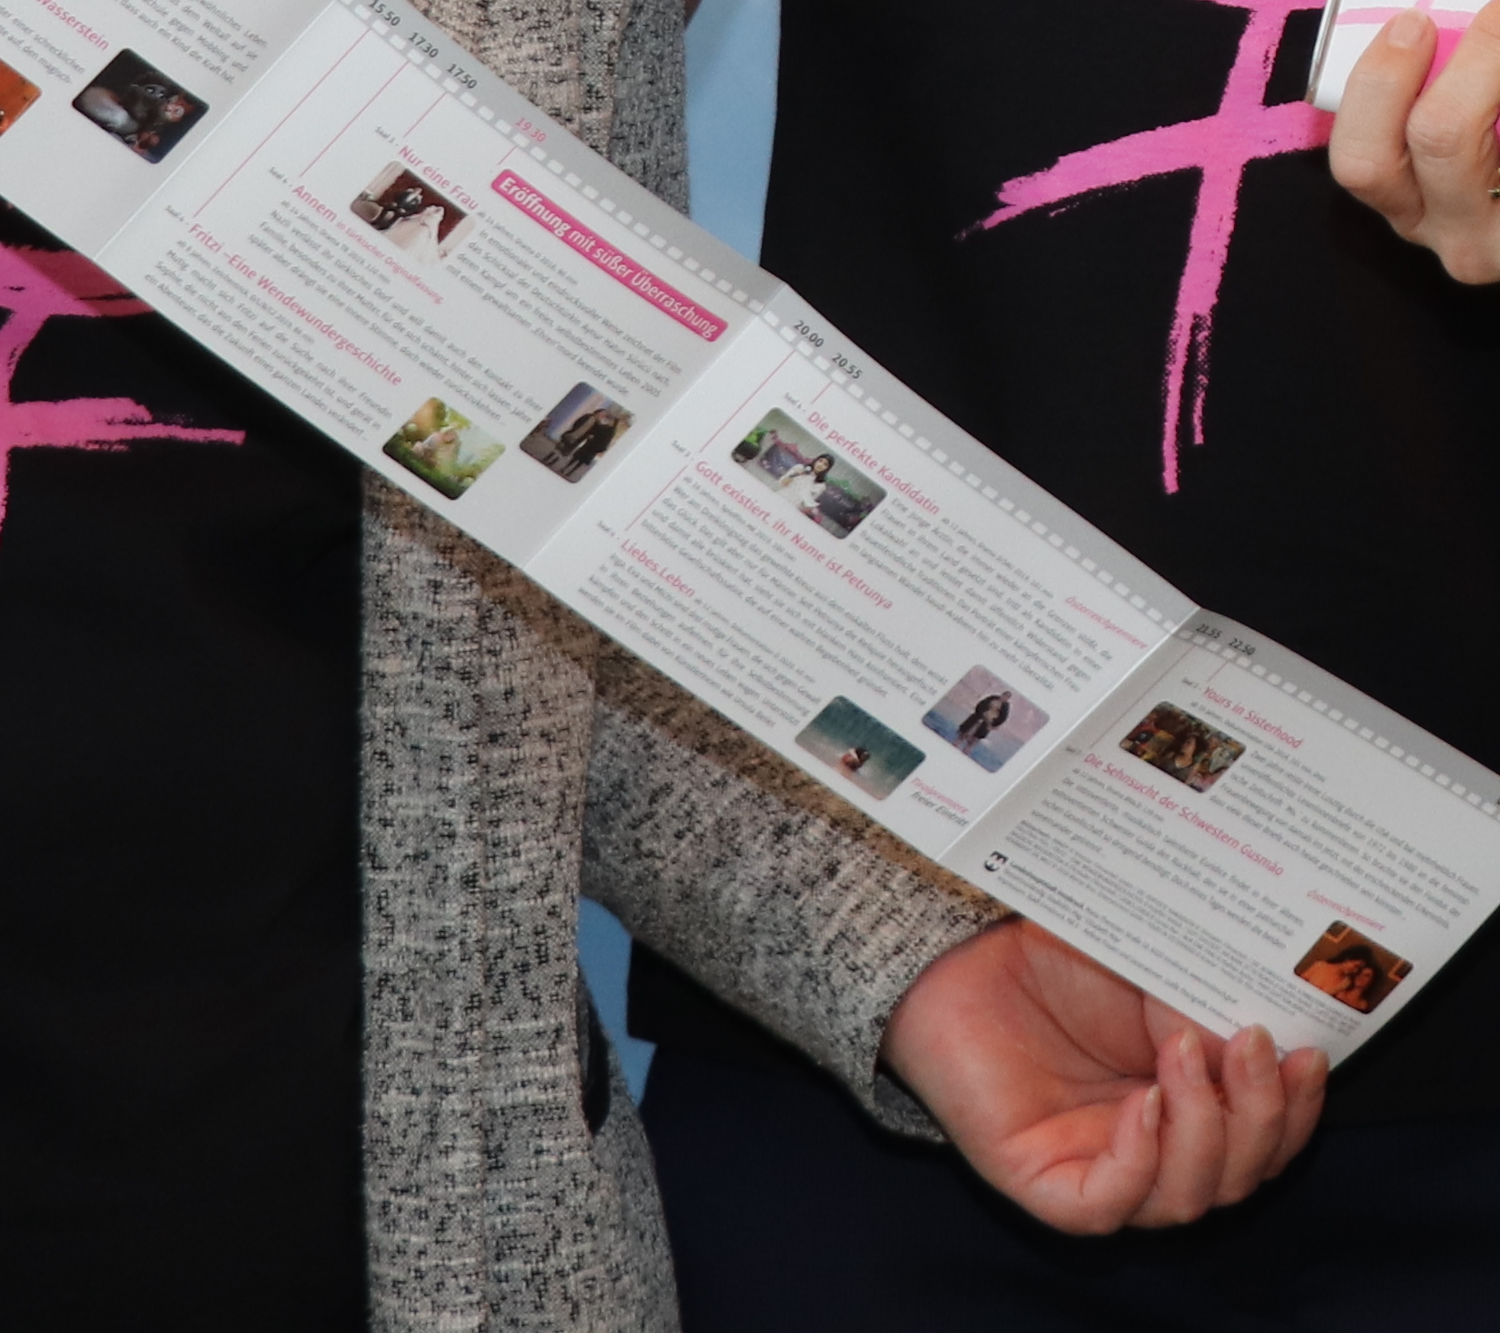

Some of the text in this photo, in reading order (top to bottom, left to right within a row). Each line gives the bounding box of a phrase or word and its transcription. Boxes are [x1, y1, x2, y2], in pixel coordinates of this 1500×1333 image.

[408, 32, 438, 58] 17.30
[447, 63, 477, 89] 17.50
[292, 182, 339, 221] Annem
[398, 145, 478, 210] Nur eine Frau
[496, 173, 721, 341] Eröffnung mit süßer Überraschung
[189, 221, 221, 252] Fritzi
[257, 272, 401, 384] Wendewundergeschichte
[1228, 636, 1257, 658] 22.50
